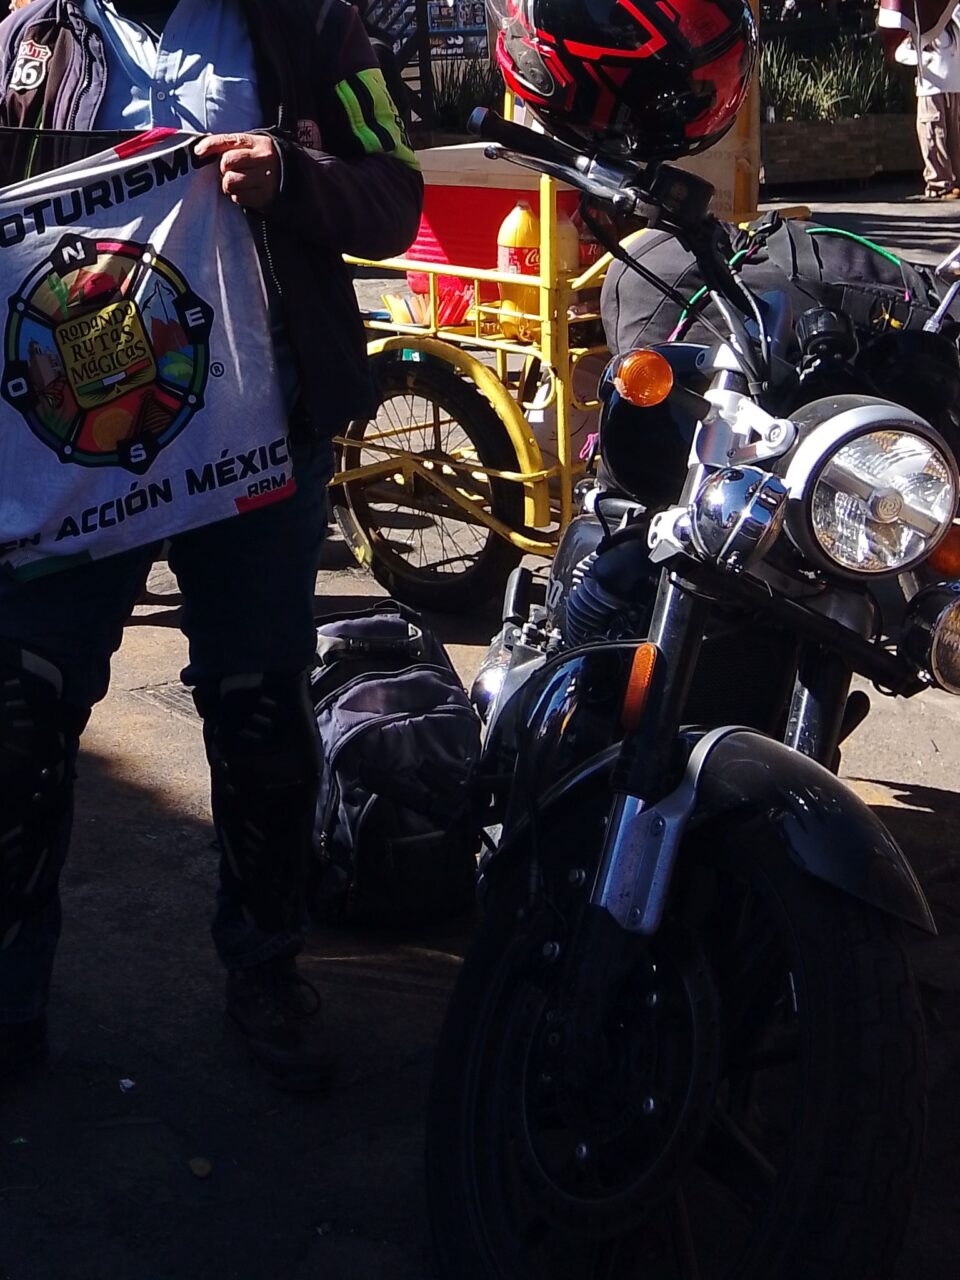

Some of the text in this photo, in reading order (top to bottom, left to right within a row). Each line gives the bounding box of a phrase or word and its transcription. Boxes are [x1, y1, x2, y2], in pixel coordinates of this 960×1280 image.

[21, 43, 50, 60] OUTE
[61, 240, 86, 264] N
[184, 306, 206, 328] E
[7, 376, 28, 398] O
[129, 443, 147, 463] S
[55, 478, 173, 542] ACCIÓN
[184, 436, 290, 496] MÉXIC
[246, 471, 287, 498] RRM
